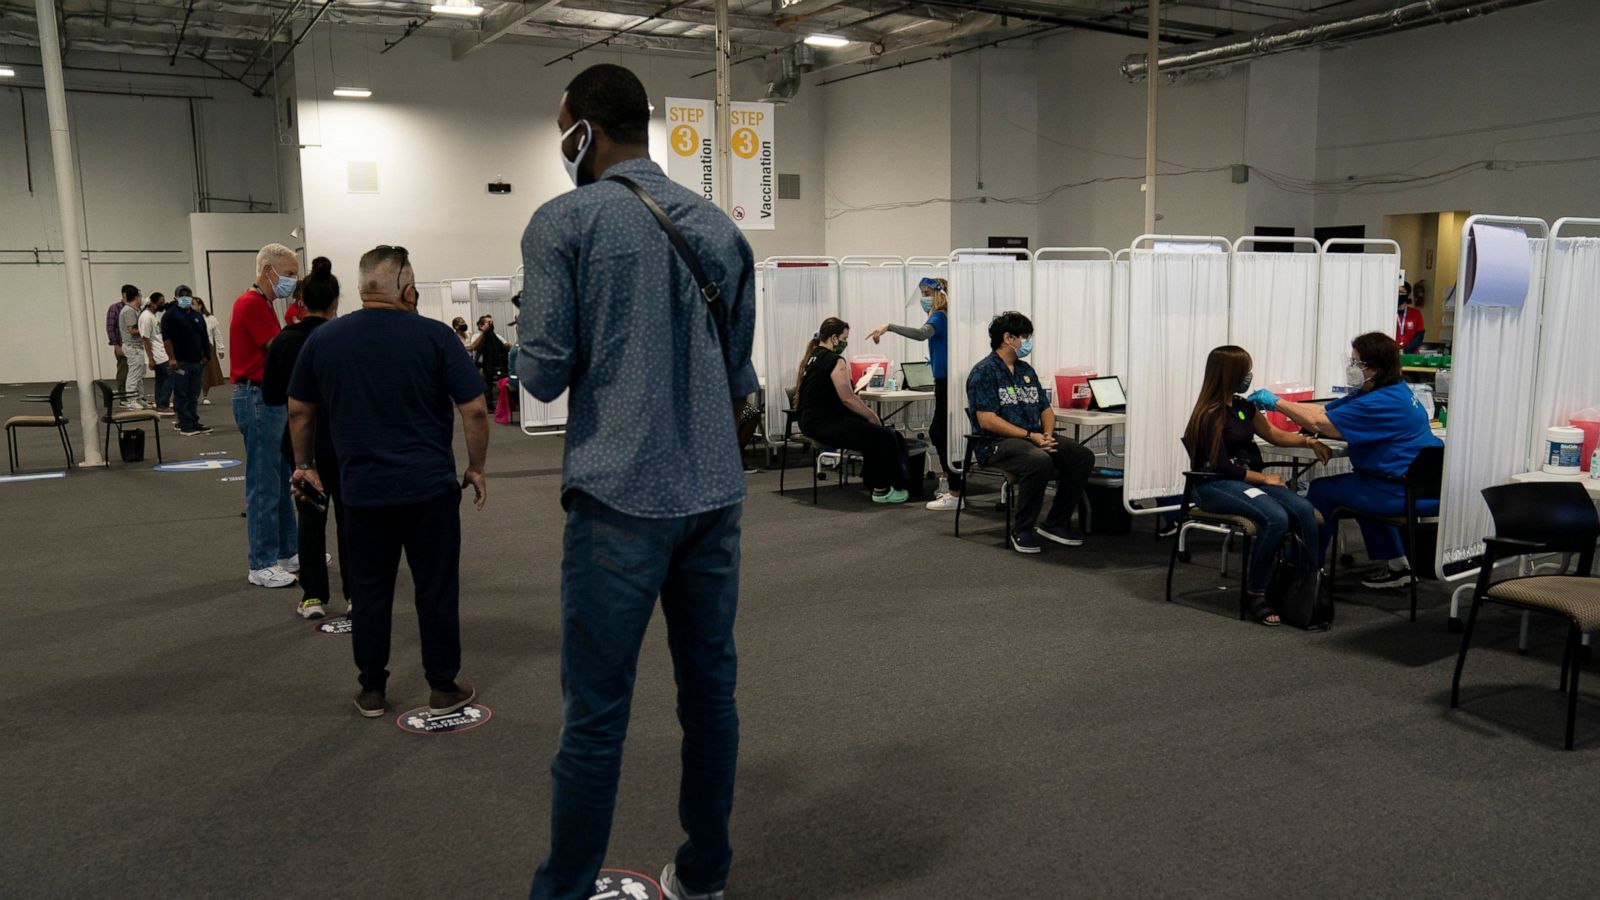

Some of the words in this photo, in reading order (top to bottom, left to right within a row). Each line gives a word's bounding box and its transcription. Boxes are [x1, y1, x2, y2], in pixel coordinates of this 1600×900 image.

[669, 107, 704, 123] STEP
[731, 111, 764, 126] STEP
[679, 128, 692, 151] 3
[740, 131, 753, 154] 3
[700, 138, 712, 201] ccination
[760, 140, 772, 219] Vaccination
[425, 718, 477, 730] DISTANCE
